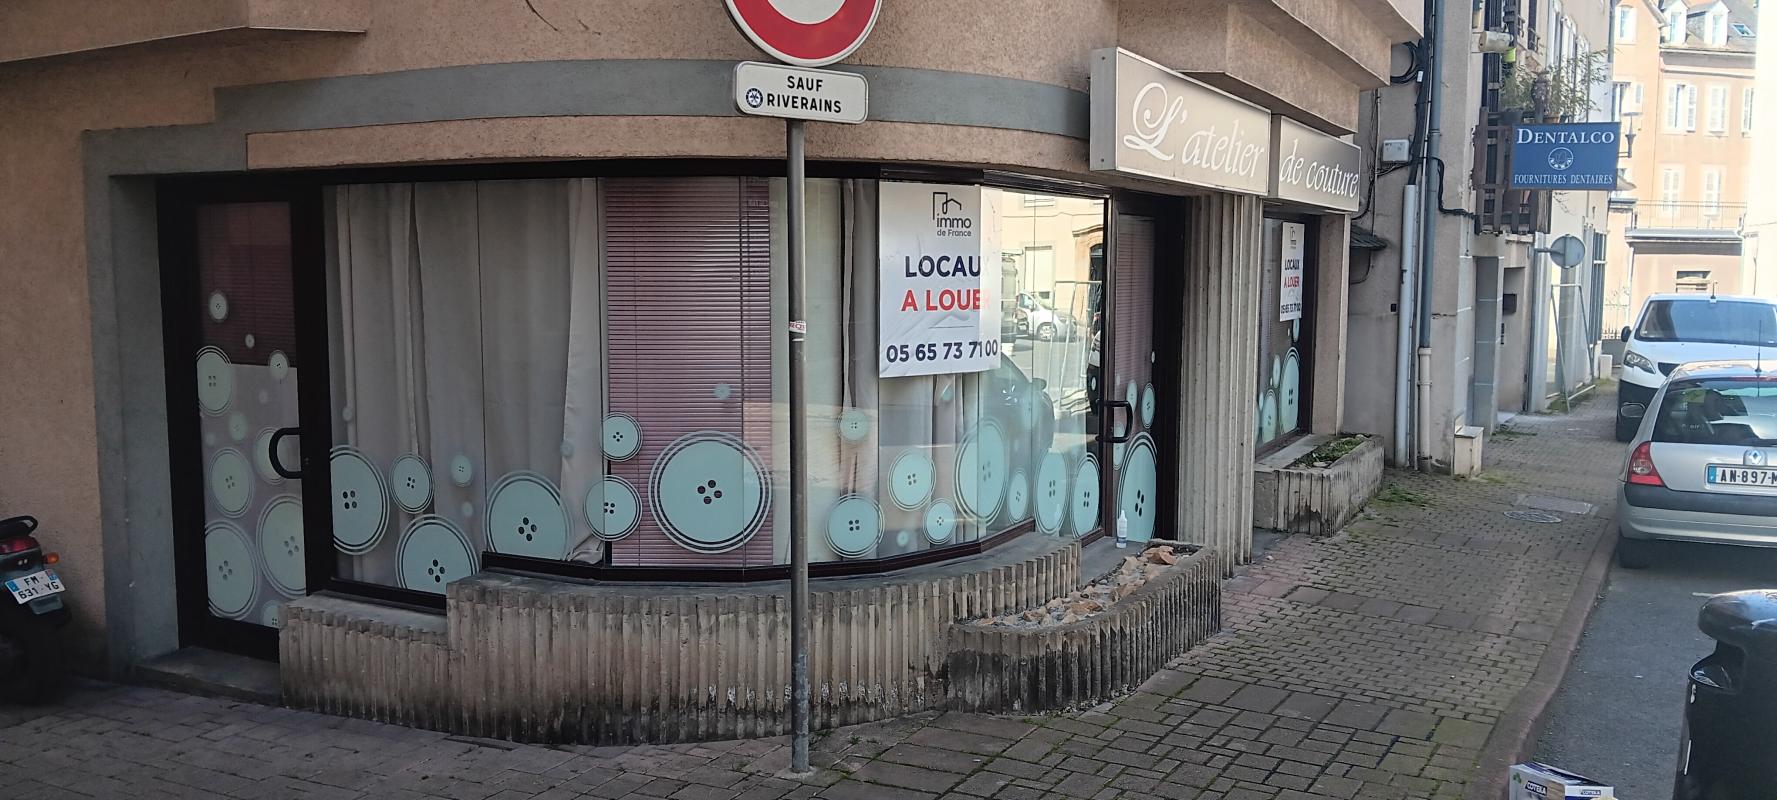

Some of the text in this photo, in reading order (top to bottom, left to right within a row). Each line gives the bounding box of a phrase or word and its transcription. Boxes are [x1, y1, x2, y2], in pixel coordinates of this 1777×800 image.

[787, 75, 824, 92] SAUF
[767, 93, 842, 114] RIVERAINS
[1123, 82, 1267, 178] L'atelier
[1516, 128, 1615, 144] DENTALCO
[1279, 138, 1360, 199] de couture
[1514, 174, 1613, 184] FOURNITURES DENTAIRES
[936, 213, 972, 229] immo
[936, 228, 972, 237] de France
[905, 255, 987, 278] LOCAU
[901, 289, 918, 311] A
[886, 344, 910, 363] 05
[915, 343, 937, 361] 65
[943, 342, 963, 360] 73
